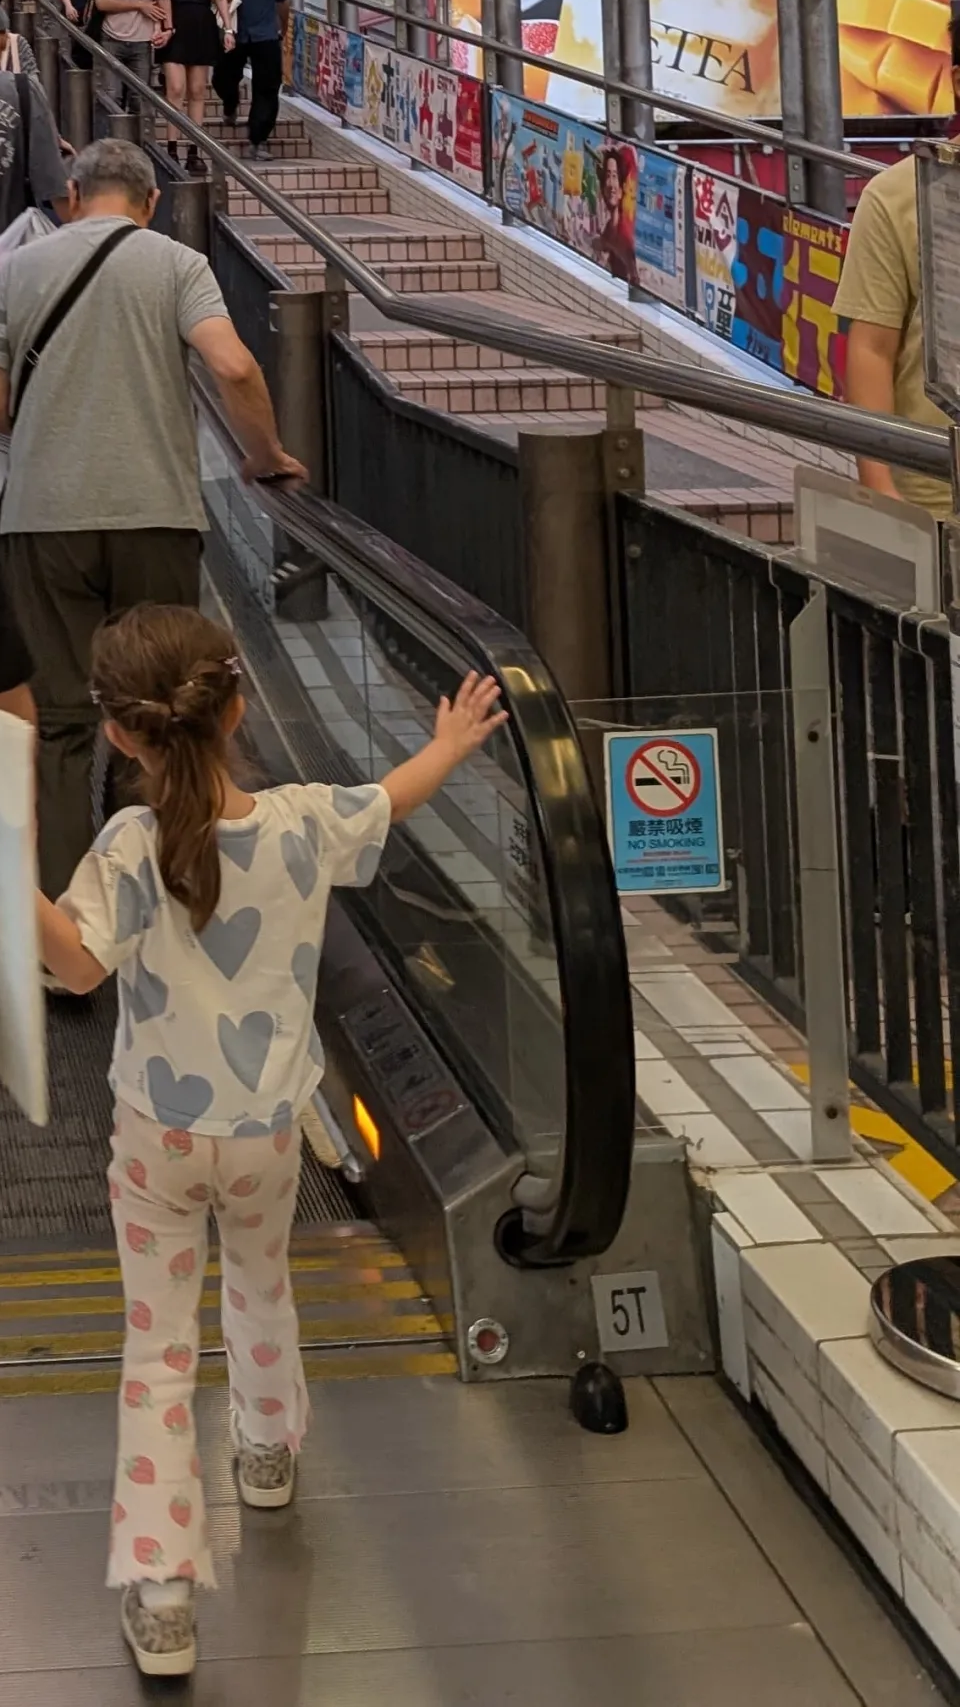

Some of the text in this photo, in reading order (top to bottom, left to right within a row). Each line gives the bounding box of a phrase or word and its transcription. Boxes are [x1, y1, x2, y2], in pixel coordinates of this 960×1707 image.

[628, 817, 704, 837] 嚴禁吸煙
[628, 836, 706, 850] NO SMOKING
[611, 1286, 647, 1336] 5T
